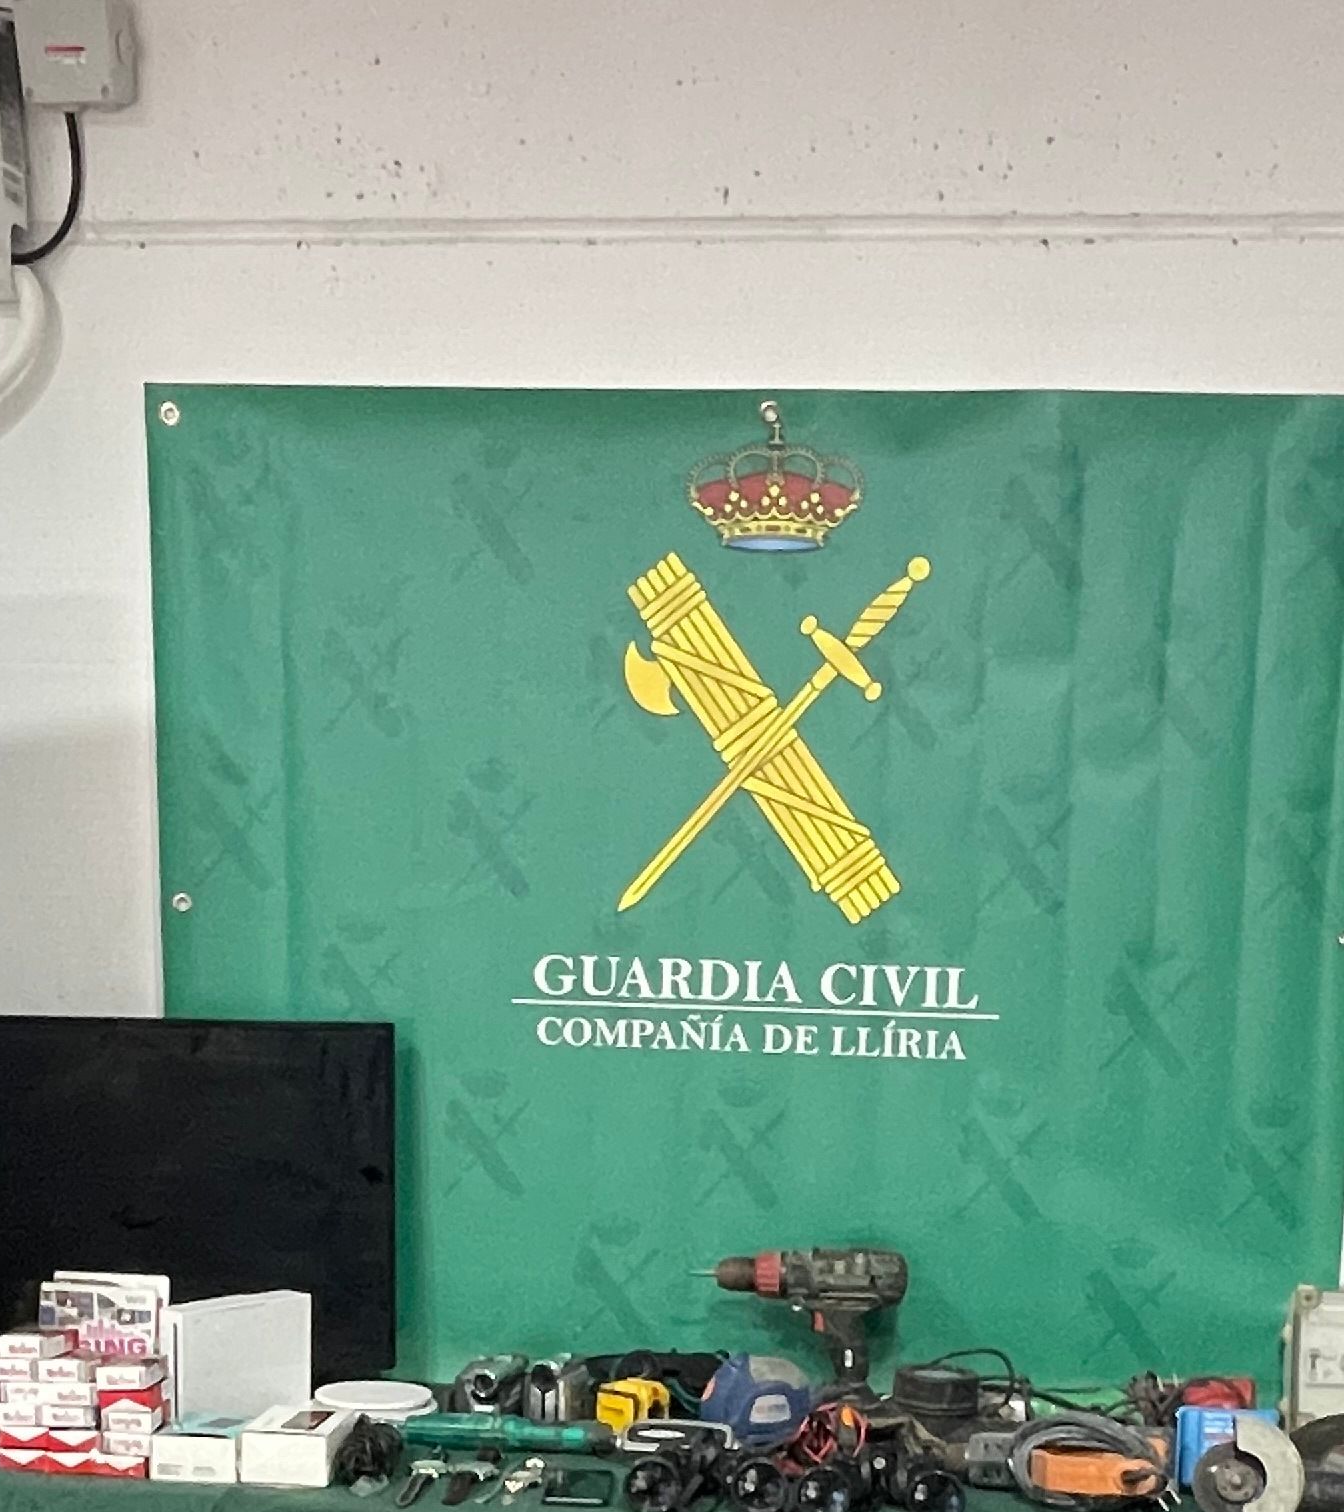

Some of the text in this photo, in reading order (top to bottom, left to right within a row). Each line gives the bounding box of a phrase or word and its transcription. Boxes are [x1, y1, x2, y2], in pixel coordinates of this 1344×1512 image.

[532, 953, 979, 1010] GUARDIA CIVIL
[535, 1014, 967, 1060] COMPAÑÍA DE LLÍRIA
